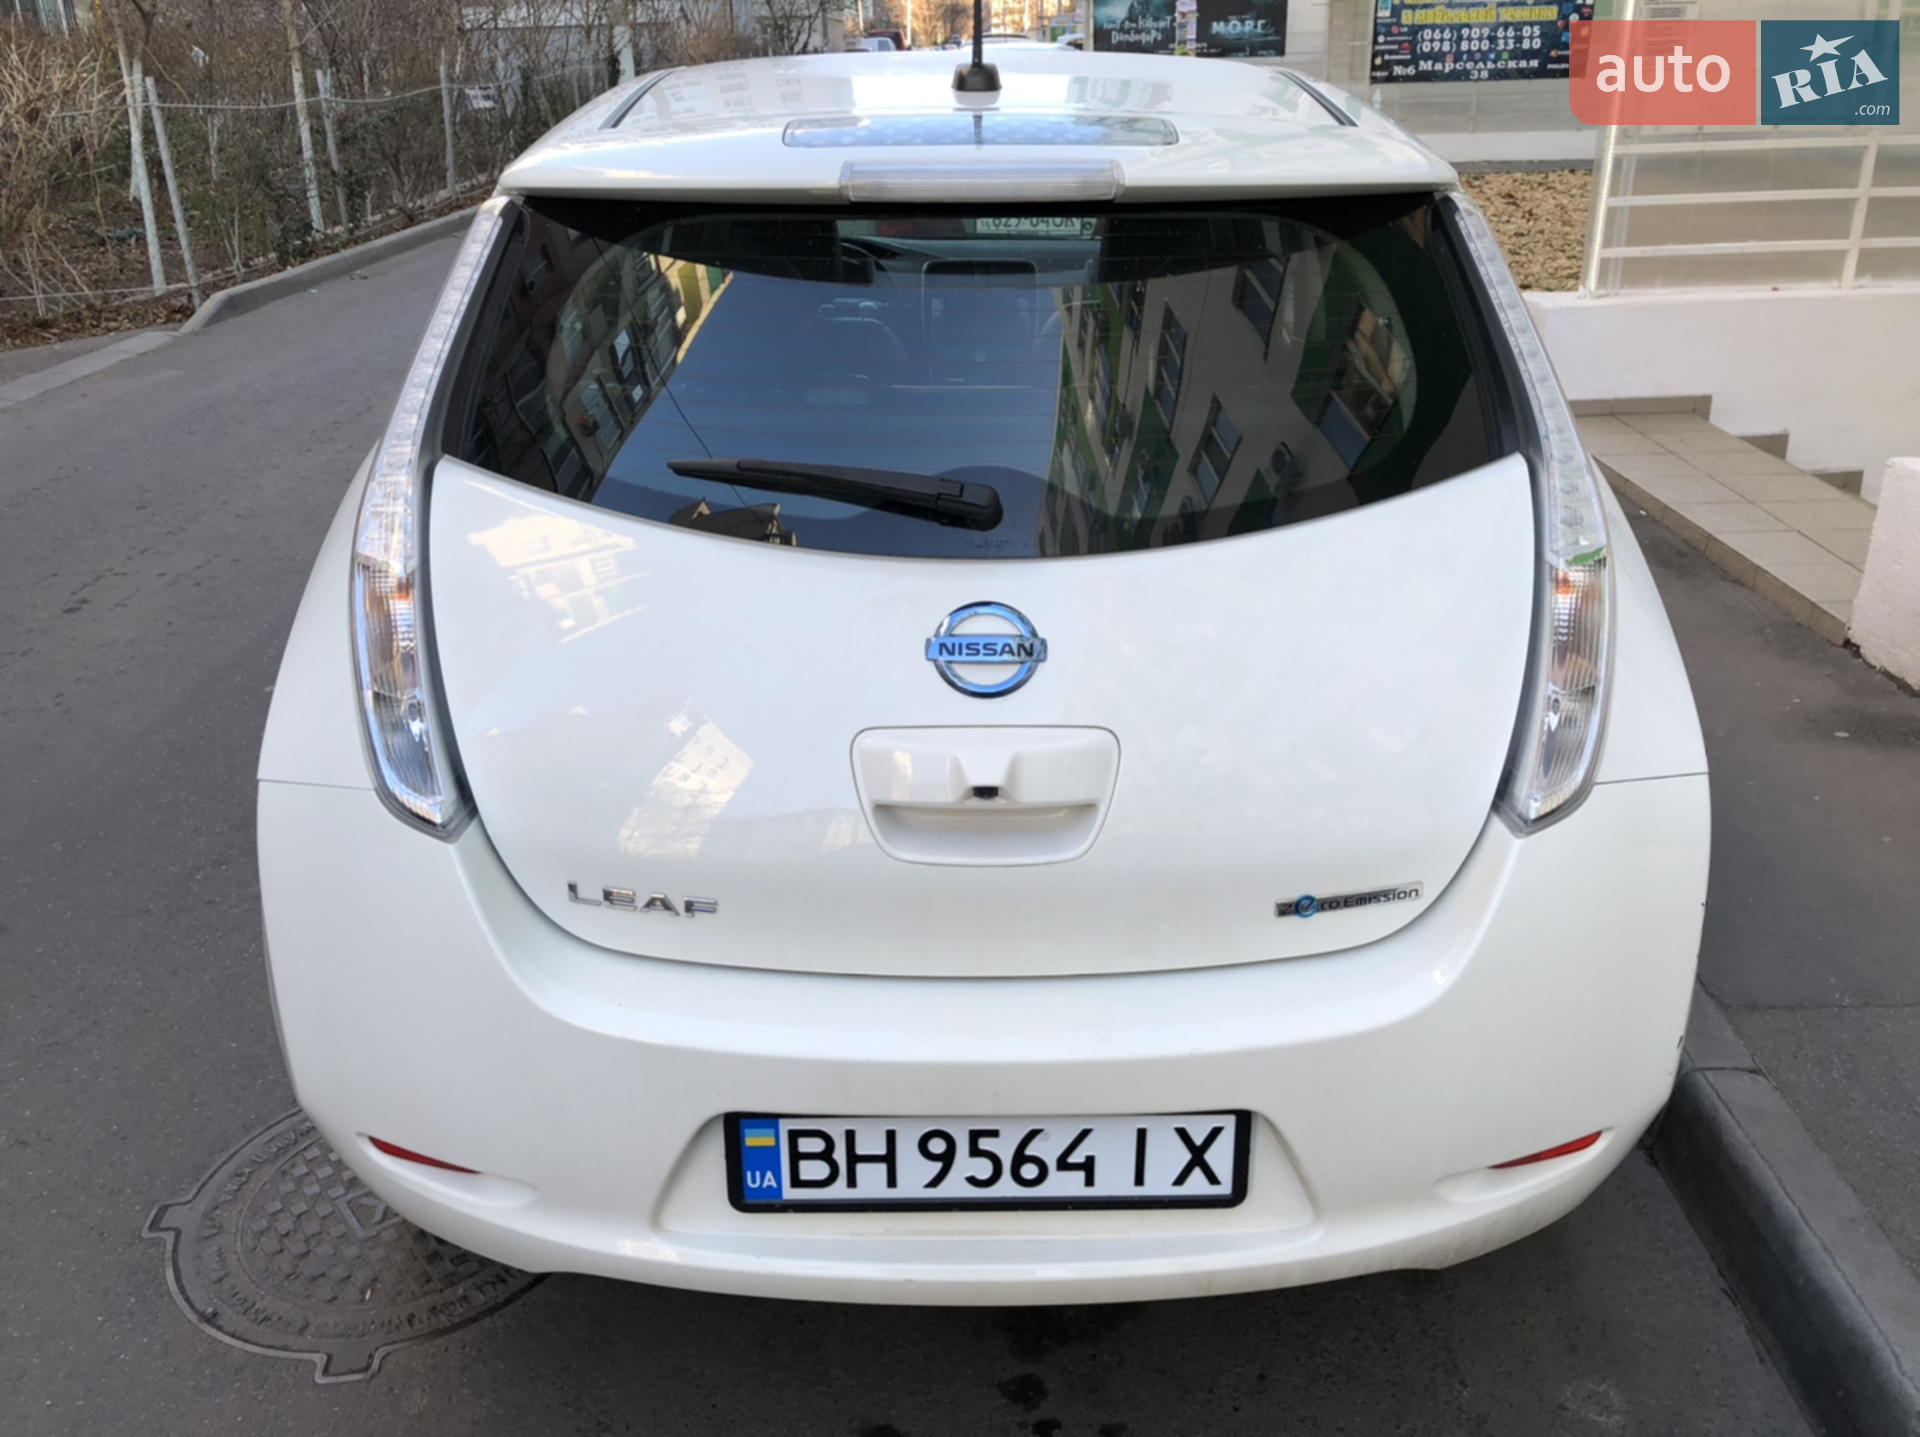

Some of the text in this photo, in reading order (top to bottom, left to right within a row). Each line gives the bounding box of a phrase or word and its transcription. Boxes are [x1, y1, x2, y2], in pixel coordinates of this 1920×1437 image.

[1417, 26, 1541, 42] (066) 909-66-05
[1416, 38, 1541, 54] (098) 800-33-80
[1418, 59, 1540, 72] Марсельская
[1470, 70, 1489, 80] 38
[938, 642, 1034, 657] NISSAN
[568, 880, 718, 918] LEAF
[747, 1170, 778, 1188] UA
[787, 1128, 897, 1189] BH
[917, 1128, 1096, 1188] 9564
